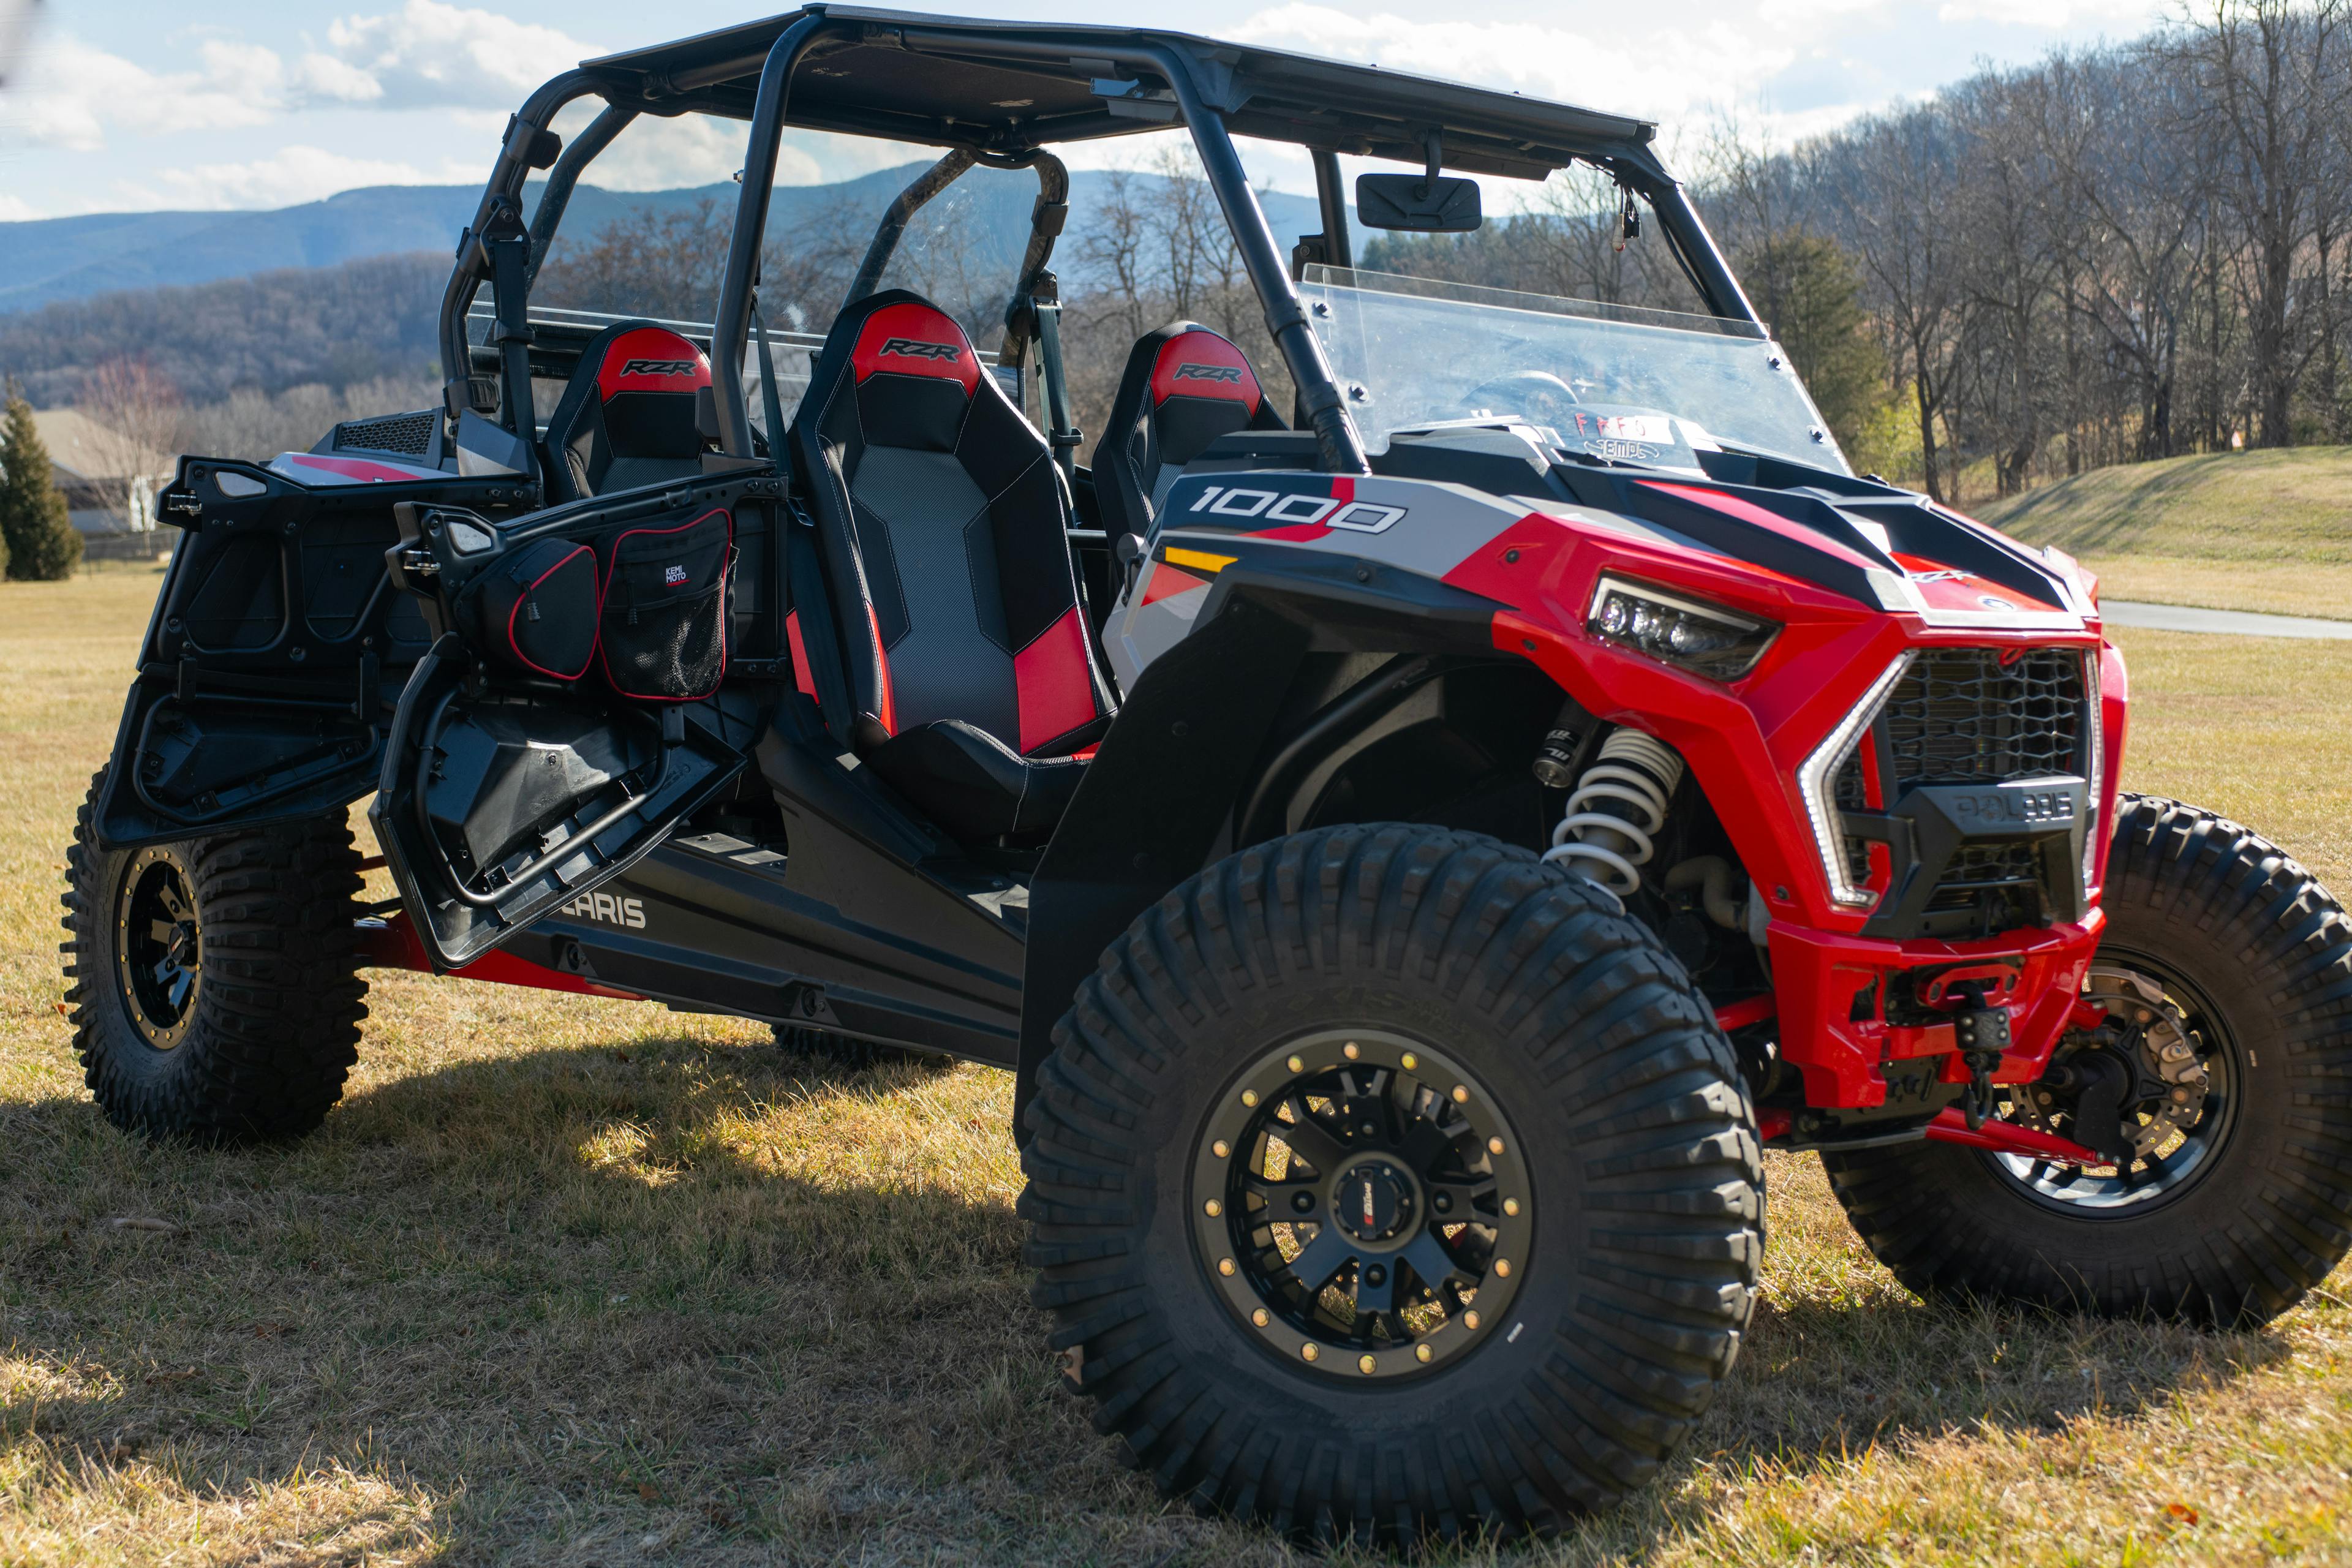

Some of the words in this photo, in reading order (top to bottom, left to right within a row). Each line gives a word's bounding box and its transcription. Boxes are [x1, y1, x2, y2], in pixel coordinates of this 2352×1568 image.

[878, 337, 961, 363] RZR
[619, 359, 696, 378] RZR
[1173, 362, 1243, 384] RZR
[1189, 486, 1408, 535] 1000
[666, 564, 682, 576] KEMI
[666, 571, 686, 584] MOTO
